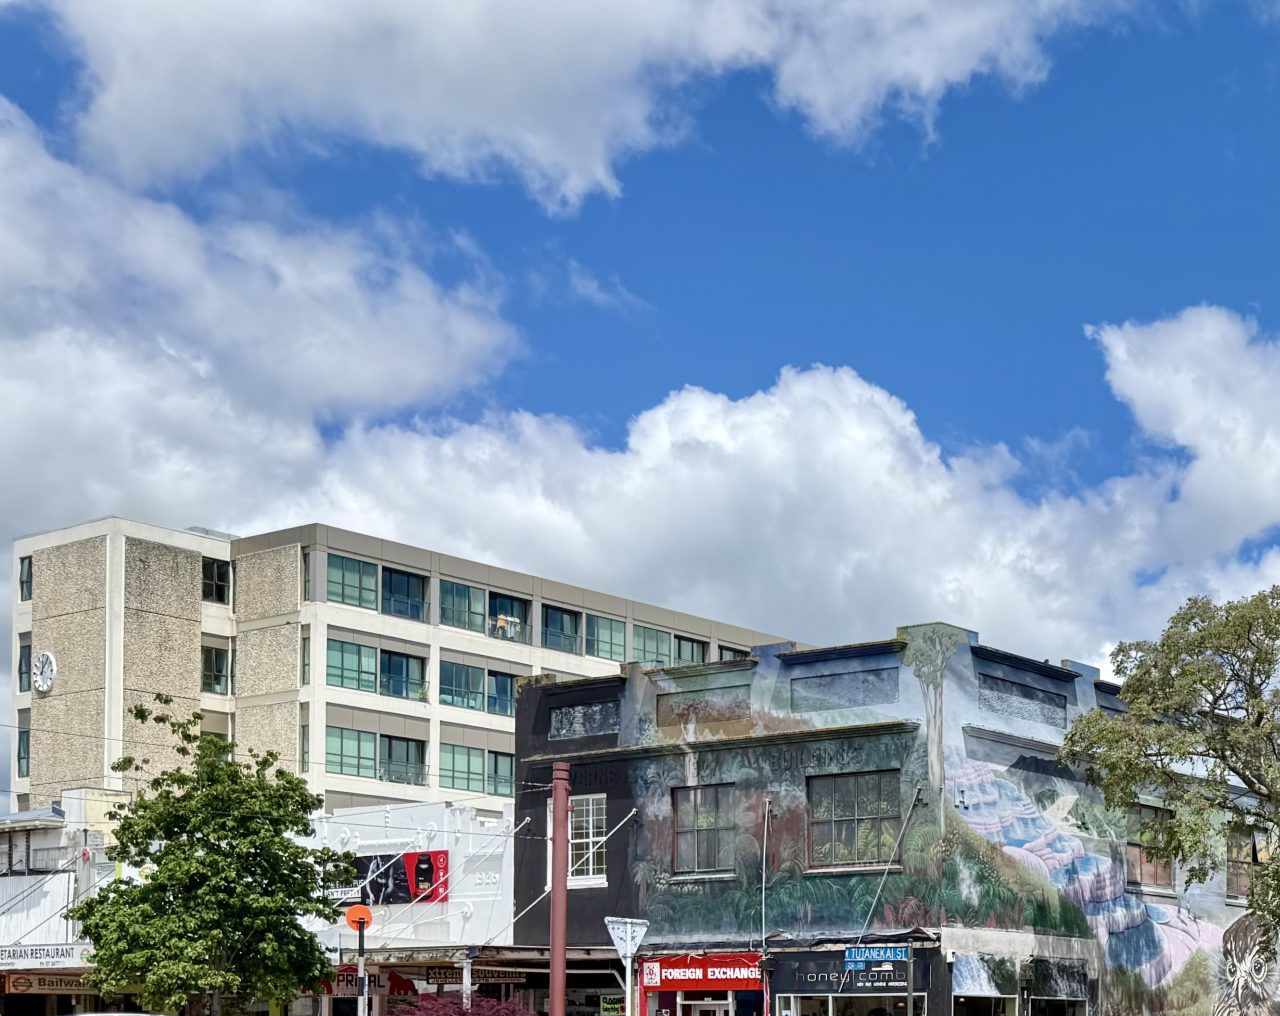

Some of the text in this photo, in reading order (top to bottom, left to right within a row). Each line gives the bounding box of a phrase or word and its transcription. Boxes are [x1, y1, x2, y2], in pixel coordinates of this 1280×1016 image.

[30, 947, 75, 960] RESTAURANT
[851, 948, 907, 959] TUTANEKAI ST
[428, 968, 463, 979] xtrem
[662, 967, 762, 980] FOREIGN EXCHANGE
[859, 969, 906, 980] comb
[336, 973, 386, 989] PRIAL
